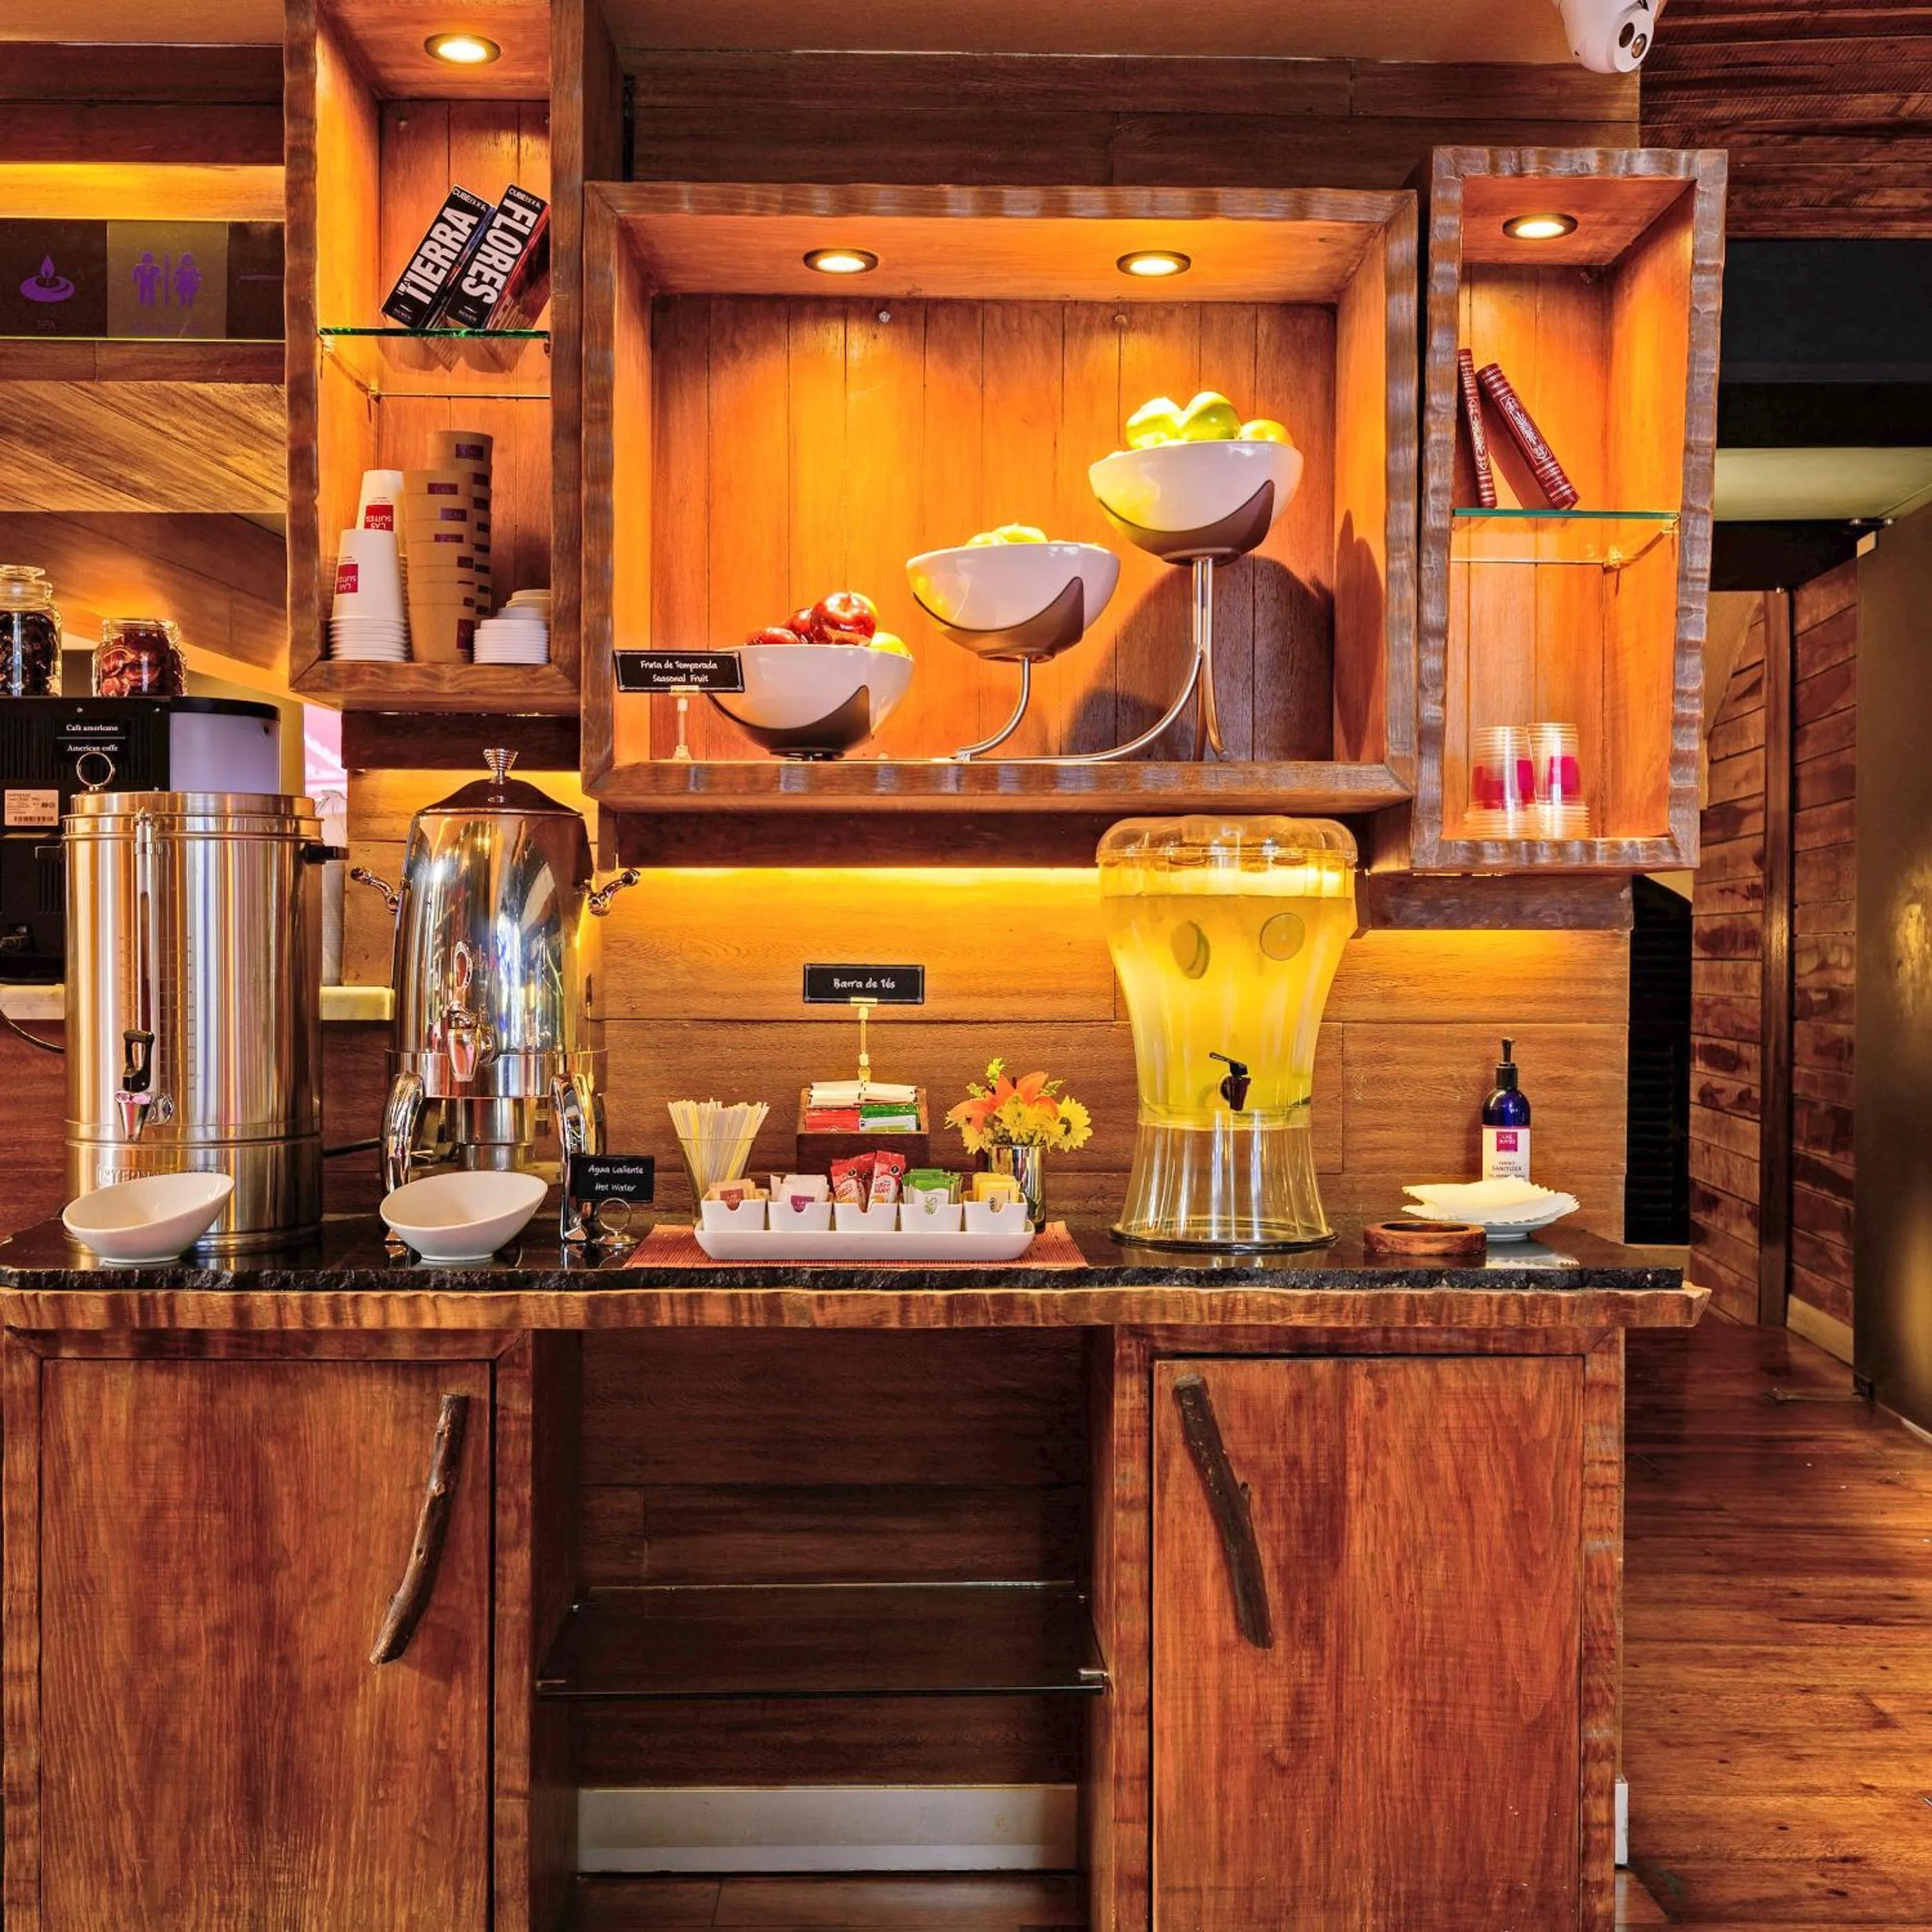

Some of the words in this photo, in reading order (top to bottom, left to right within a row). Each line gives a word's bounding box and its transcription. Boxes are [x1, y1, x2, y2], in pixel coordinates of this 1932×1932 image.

[405, 206, 480, 304] TIERRA
[461, 199, 539, 304] FLORES
[365, 515, 392, 523] SUITES
[640, 660, 662, 669] Fruta
[664, 660, 673, 669] de
[675, 660, 718, 671] Temporada
[653, 673, 686, 682] Seasonal
[690, 674, 709, 682] Fruit
[66, 744, 101, 752] American
[833, 978, 862, 989] Barra
[865, 977, 878, 989] de
[588, 1164, 610, 1176] Agua
[595, 1181, 609, 1192] Hot
